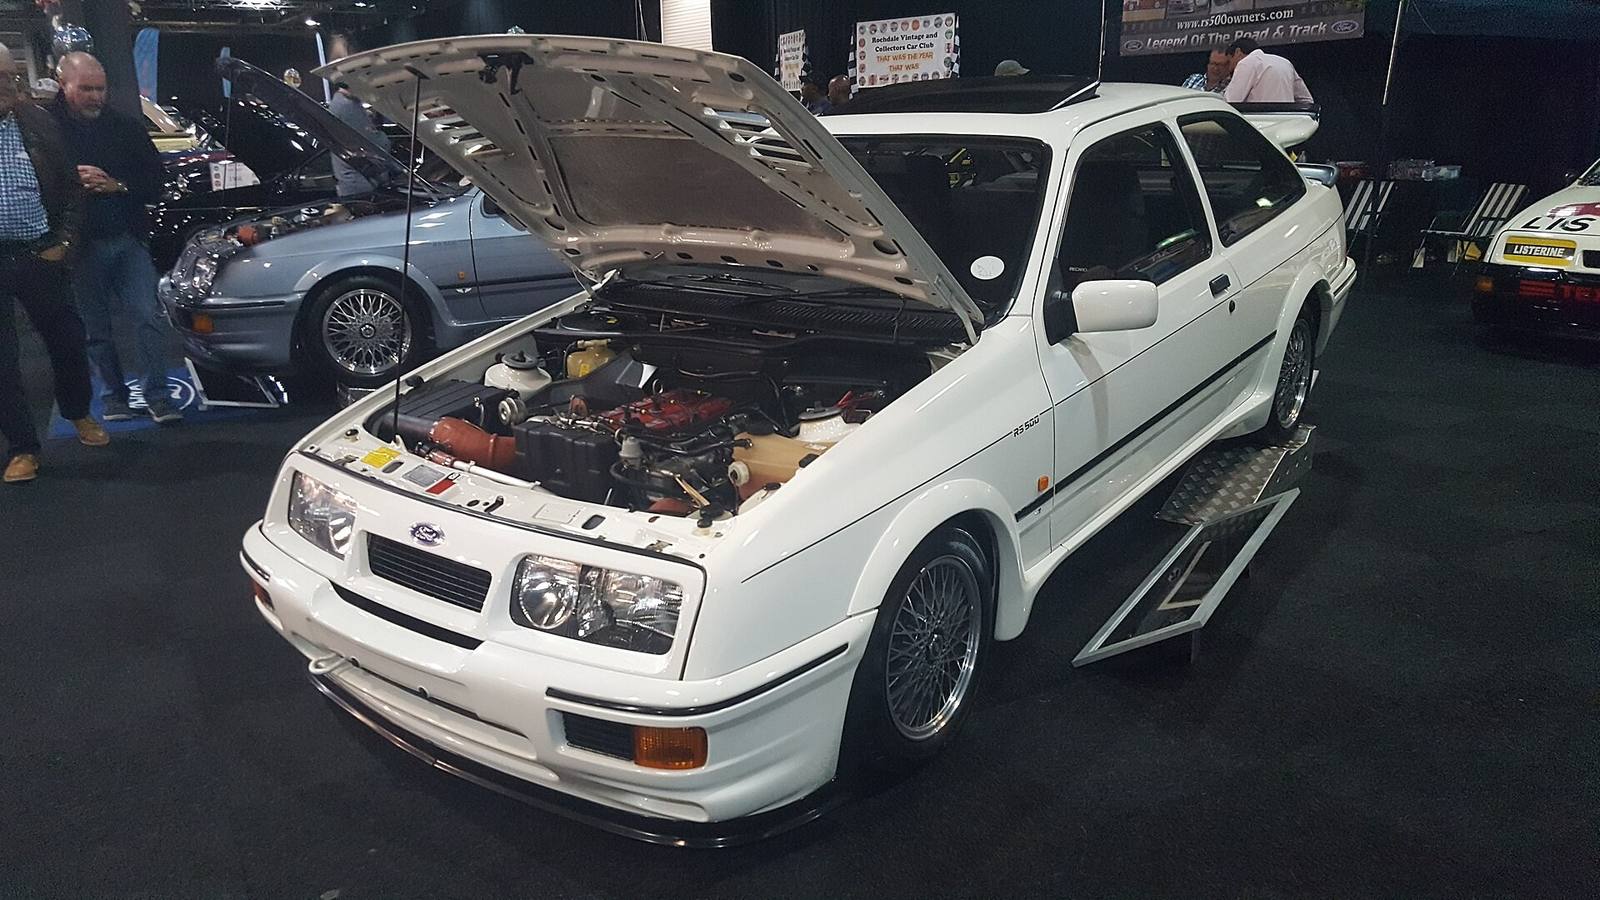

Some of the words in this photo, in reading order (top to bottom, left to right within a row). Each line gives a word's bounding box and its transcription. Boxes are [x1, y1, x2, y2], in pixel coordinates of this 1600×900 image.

[1176, 9, 1294, 30] www.rs500owners.com
[872, 35, 899, 43] Rochdale
[900, 33, 924, 41] Vintage
[1146, 35, 1187, 49] Legend
[1190, 34, 1204, 45] Of
[1207, 32, 1230, 44] The
[1272, 25, 1284, 39] &
[1289, 21, 1328, 38] Track
[875, 43, 905, 52] Collectors
[876, 54, 892, 62] THAT
[907, 52, 918, 60] THE
[918, 51, 934, 60] YEAR
[889, 64, 904, 72] THAT
[905, 63, 919, 71] WAS
[1513, 245, 1565, 257] LISTERINE
[1013, 424, 1024, 438] RS
[1024, 414, 1040, 431] 500
